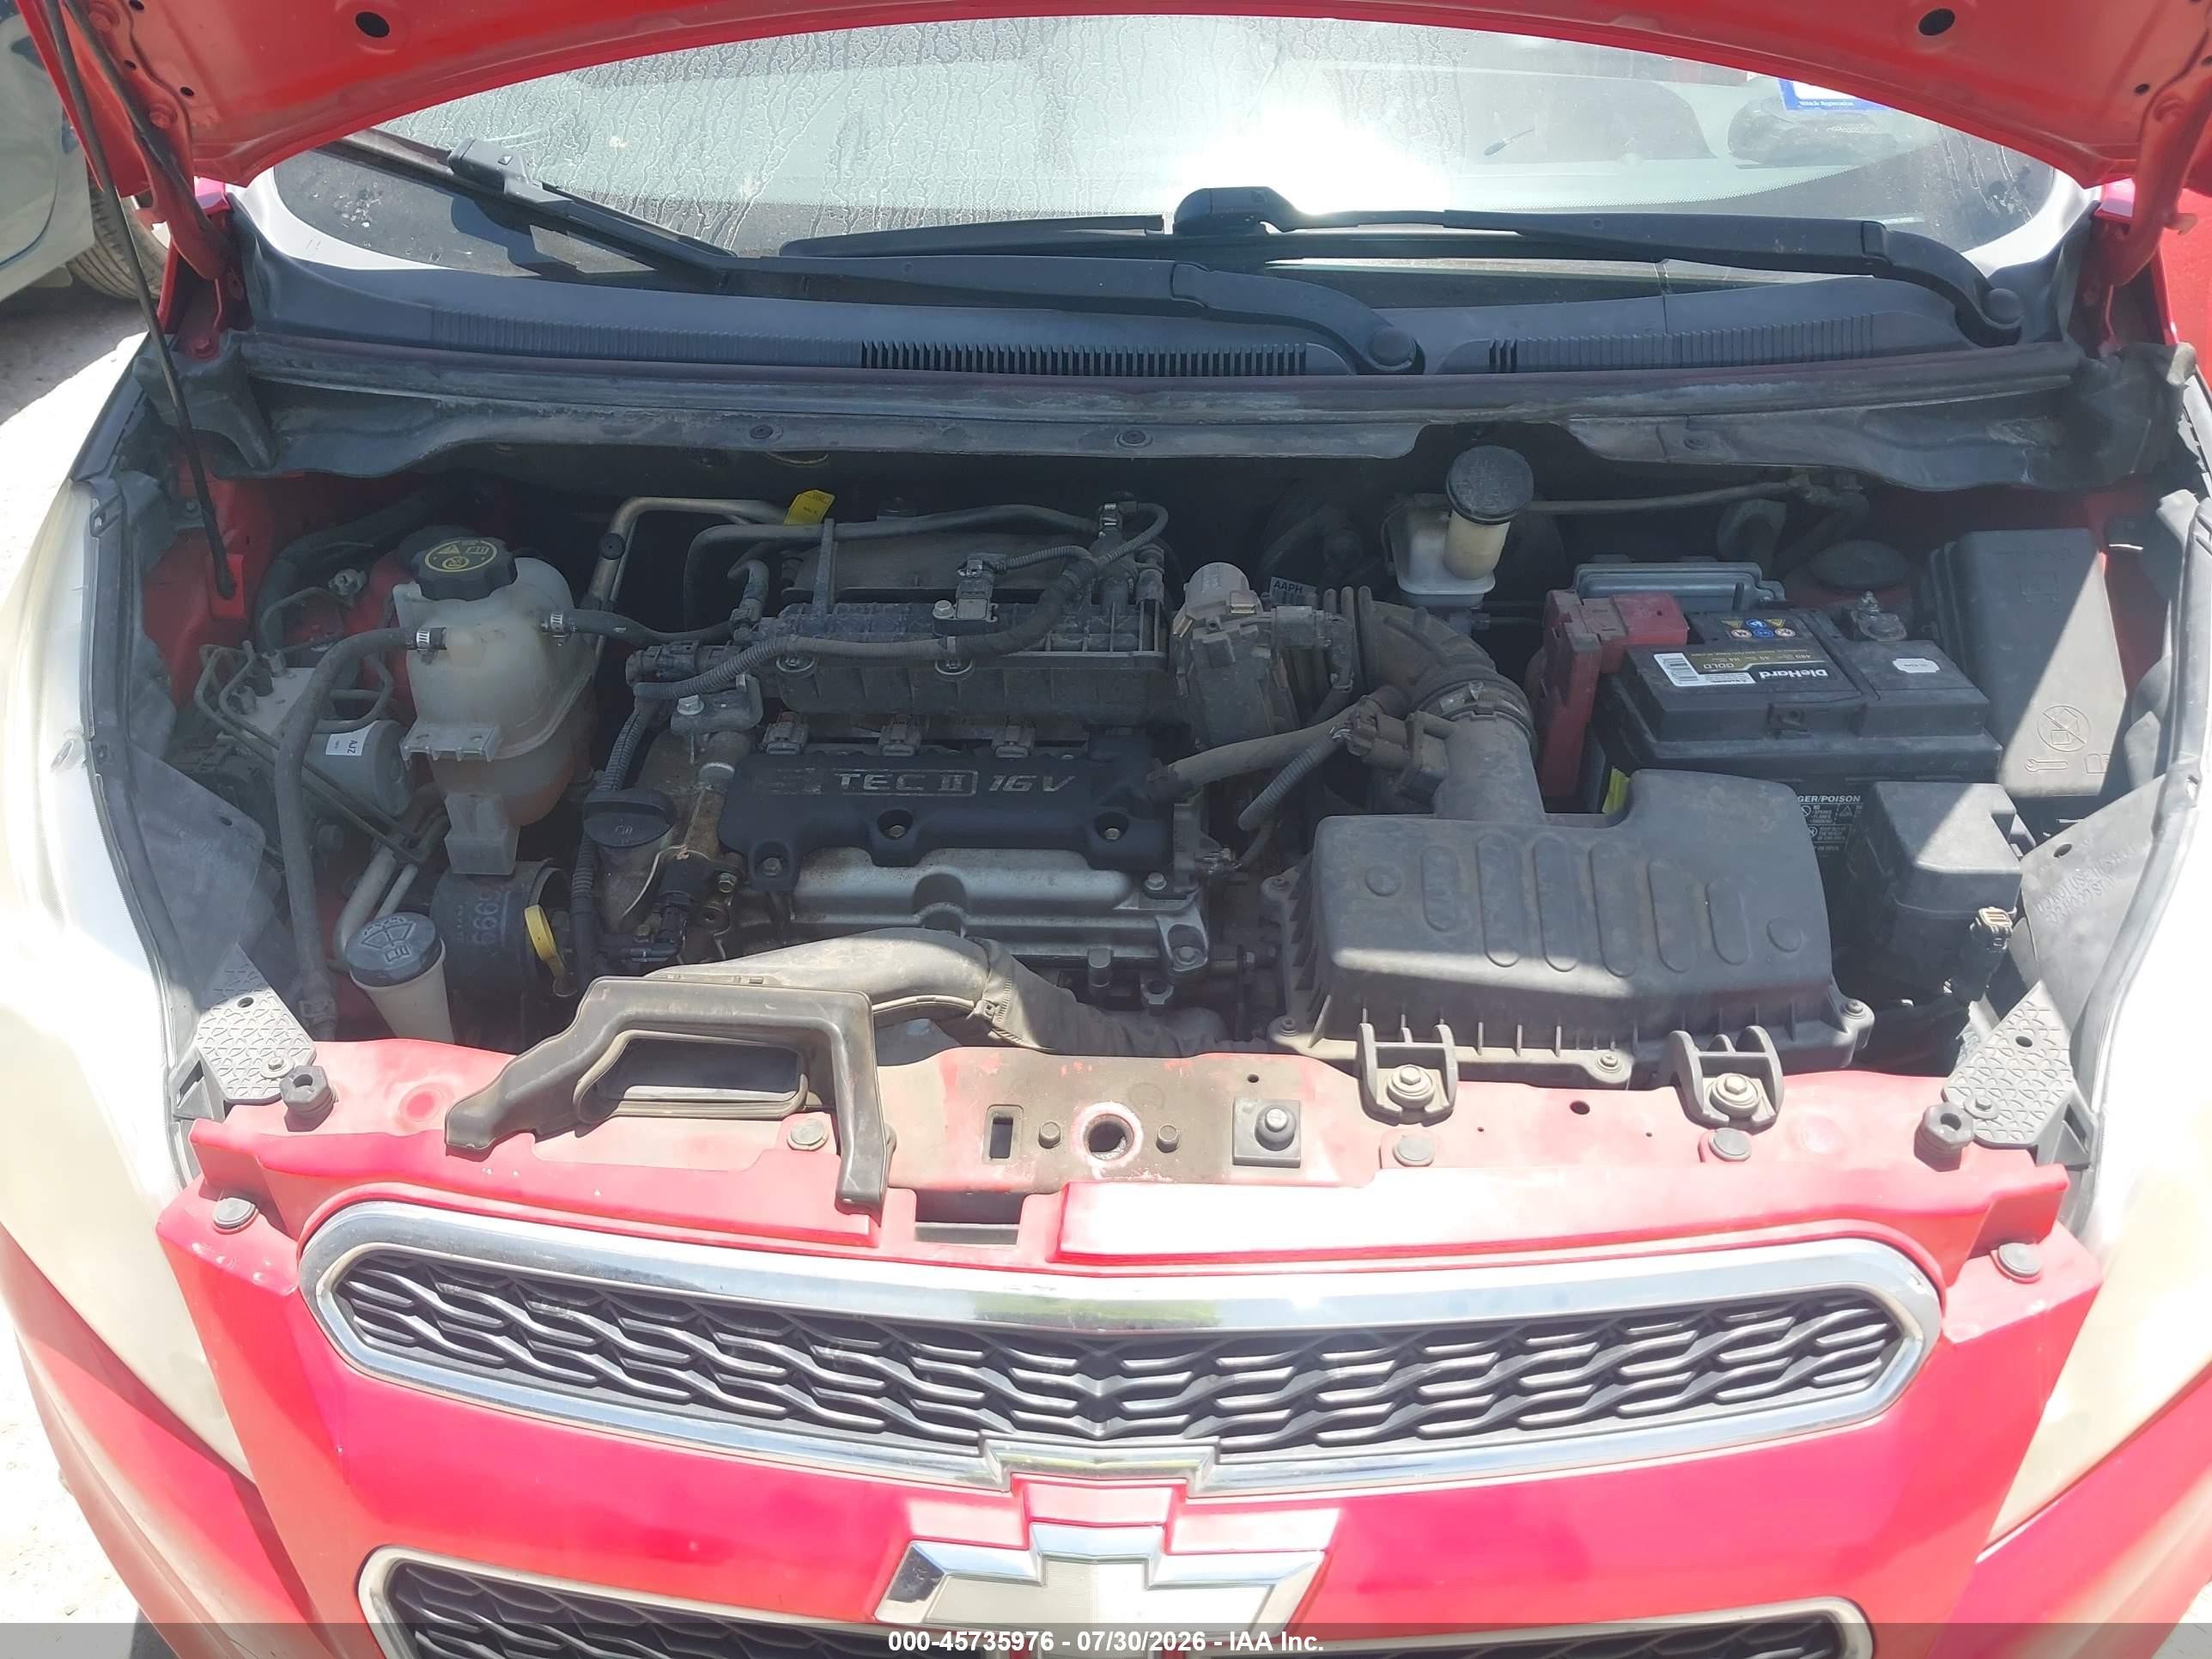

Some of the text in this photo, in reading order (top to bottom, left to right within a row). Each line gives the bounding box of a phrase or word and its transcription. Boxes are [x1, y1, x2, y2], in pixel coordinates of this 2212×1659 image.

[1273, 580, 1303, 594] AAPH
[1758, 669, 1829, 679] DieHard
[347, 739, 358, 754] AJZ
